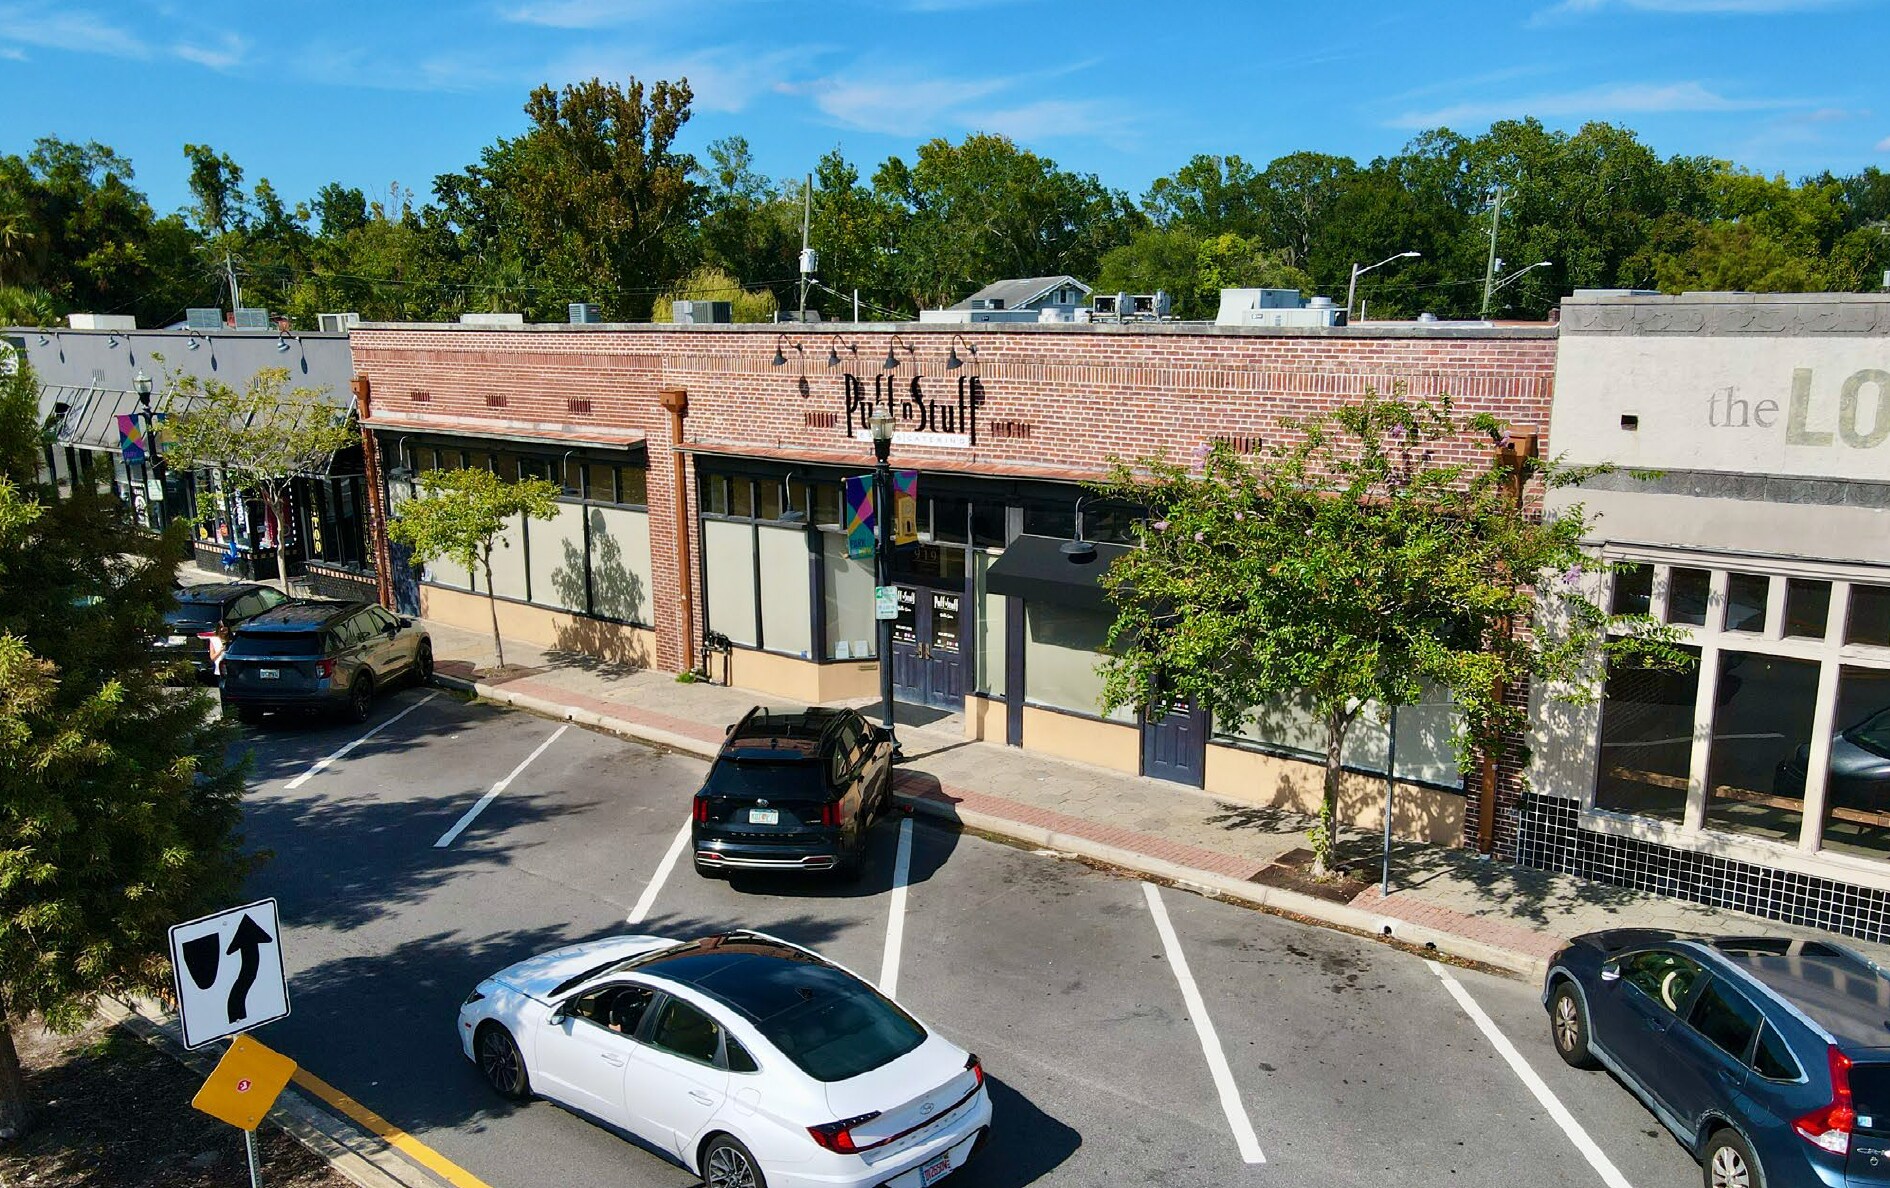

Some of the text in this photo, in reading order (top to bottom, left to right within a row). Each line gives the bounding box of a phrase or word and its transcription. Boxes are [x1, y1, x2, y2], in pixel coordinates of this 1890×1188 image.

[910, 374, 981, 446] Stuff
[1706, 367, 1890, 450] the LO
[234, 488, 246, 526] TOBACC
